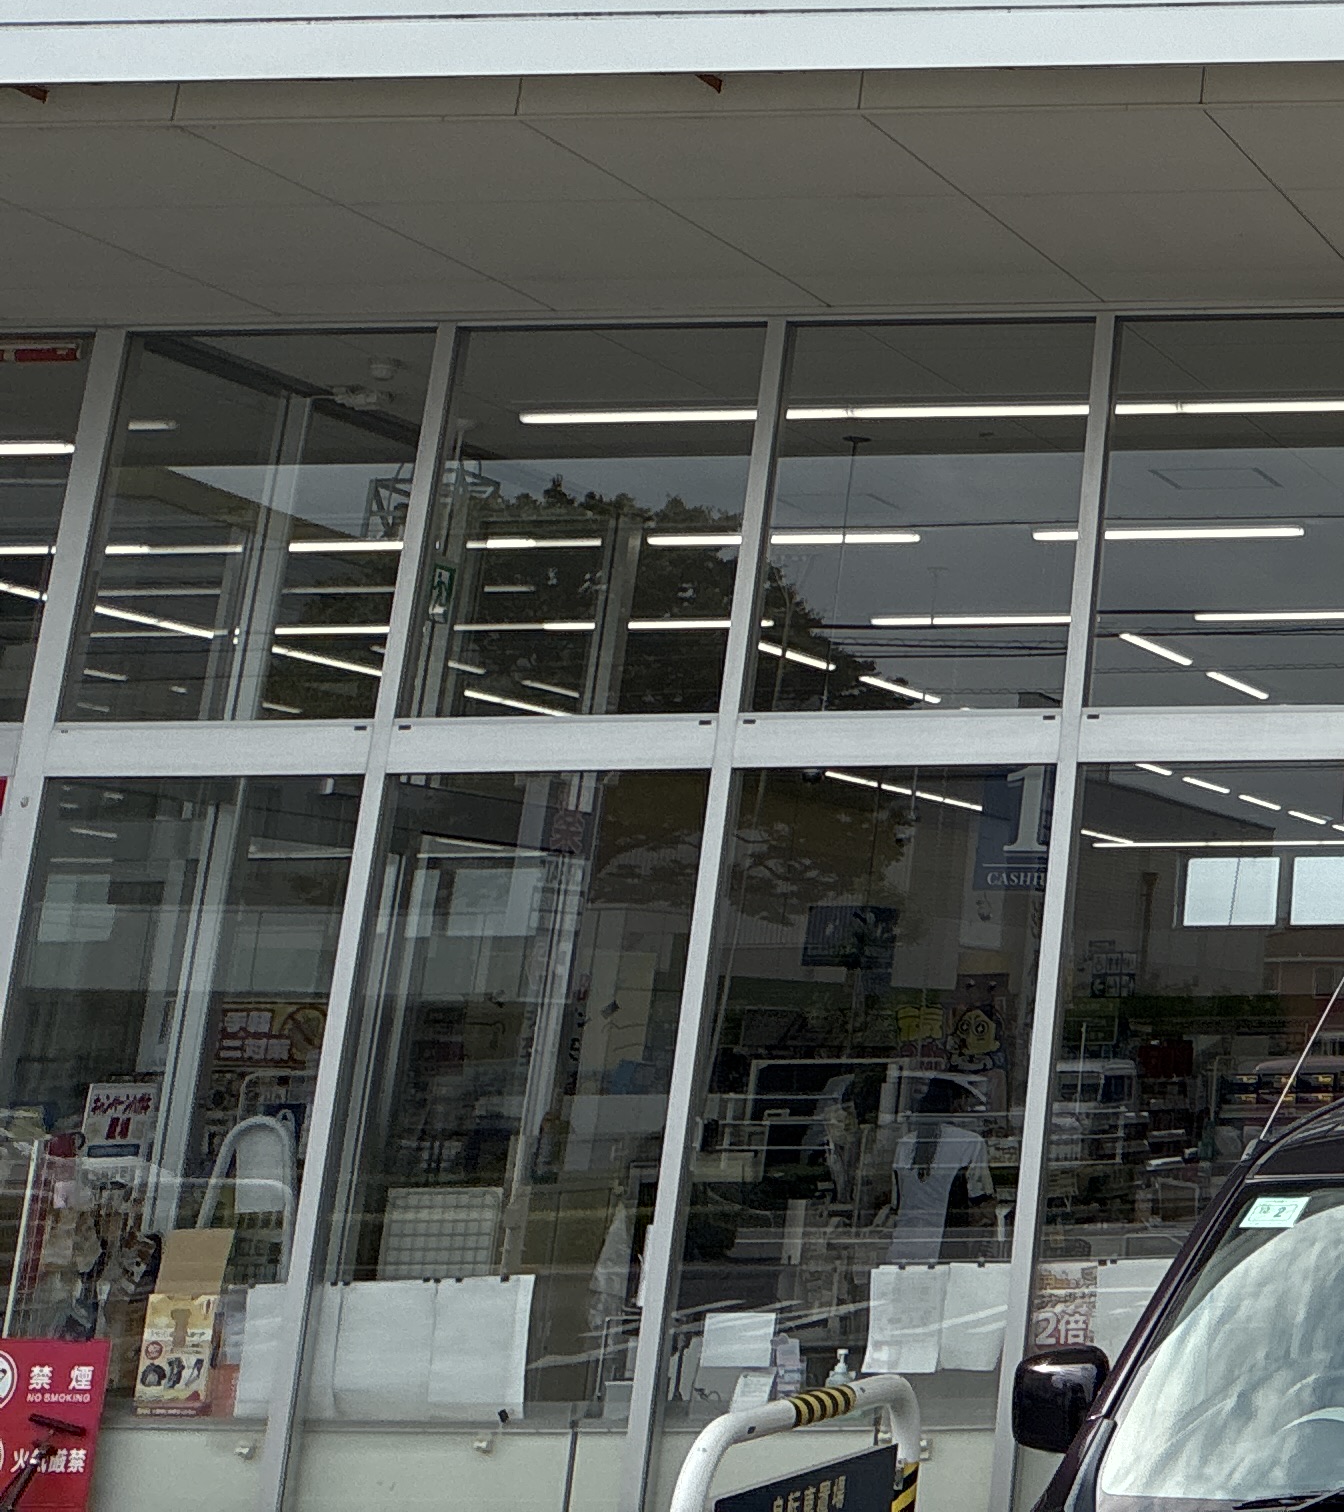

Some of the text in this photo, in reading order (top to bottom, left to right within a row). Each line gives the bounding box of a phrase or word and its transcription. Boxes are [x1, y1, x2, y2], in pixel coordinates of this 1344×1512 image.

[1034, 1311, 1088, 1345] 2倍
[27, 1364, 95, 1390] 禁煙
[26, 1392, 91, 1403] NO SMOKING
